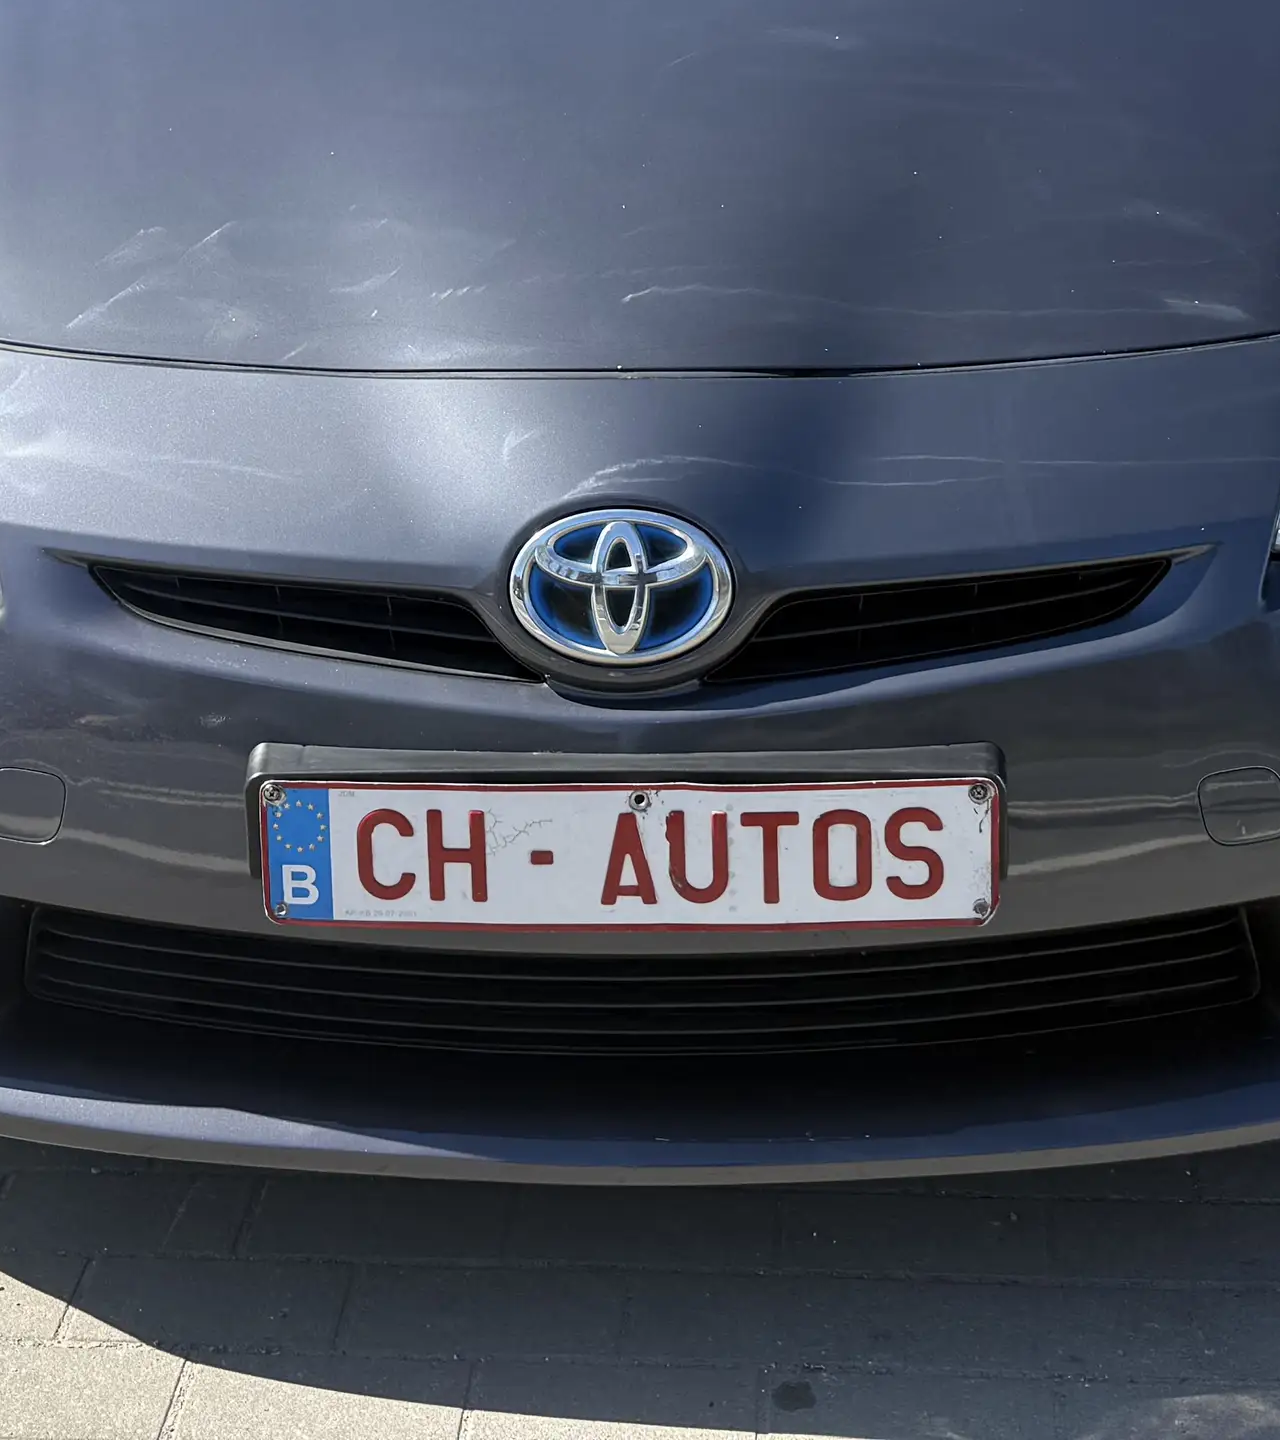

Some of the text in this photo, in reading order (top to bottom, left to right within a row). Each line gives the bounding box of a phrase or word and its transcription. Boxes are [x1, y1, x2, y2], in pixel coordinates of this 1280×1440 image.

[282, 864, 320, 905] B
[356, 808, 488, 902] CH
[600, 806, 945, 905] AUTOS
